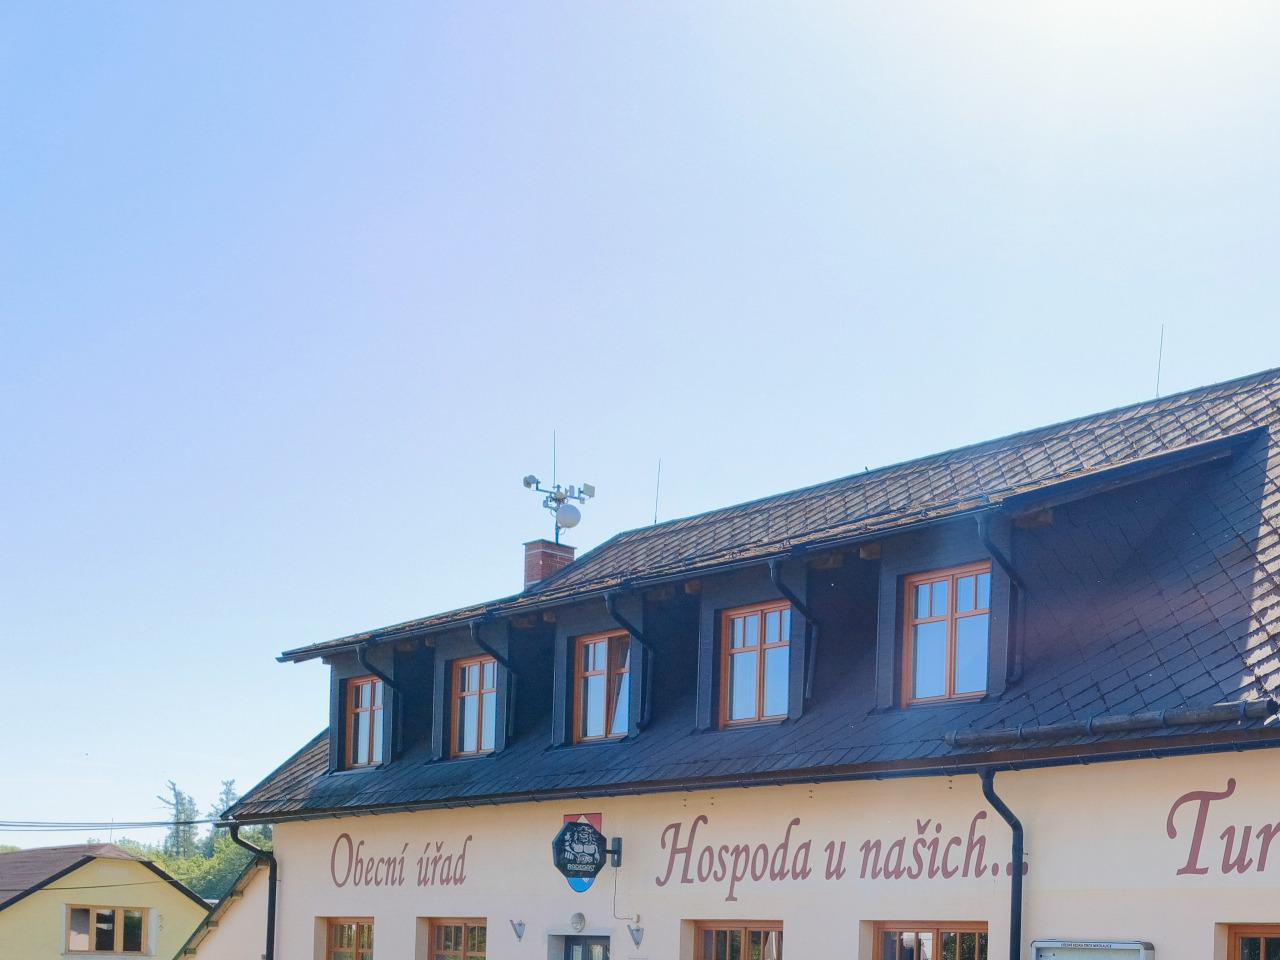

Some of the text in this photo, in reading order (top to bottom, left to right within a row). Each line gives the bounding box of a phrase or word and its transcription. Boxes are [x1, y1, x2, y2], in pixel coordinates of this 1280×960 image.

[331, 833, 473, 888] Obecní úřad
[655, 815, 812, 902] Hospoda
[825, 841, 846, 881] u
